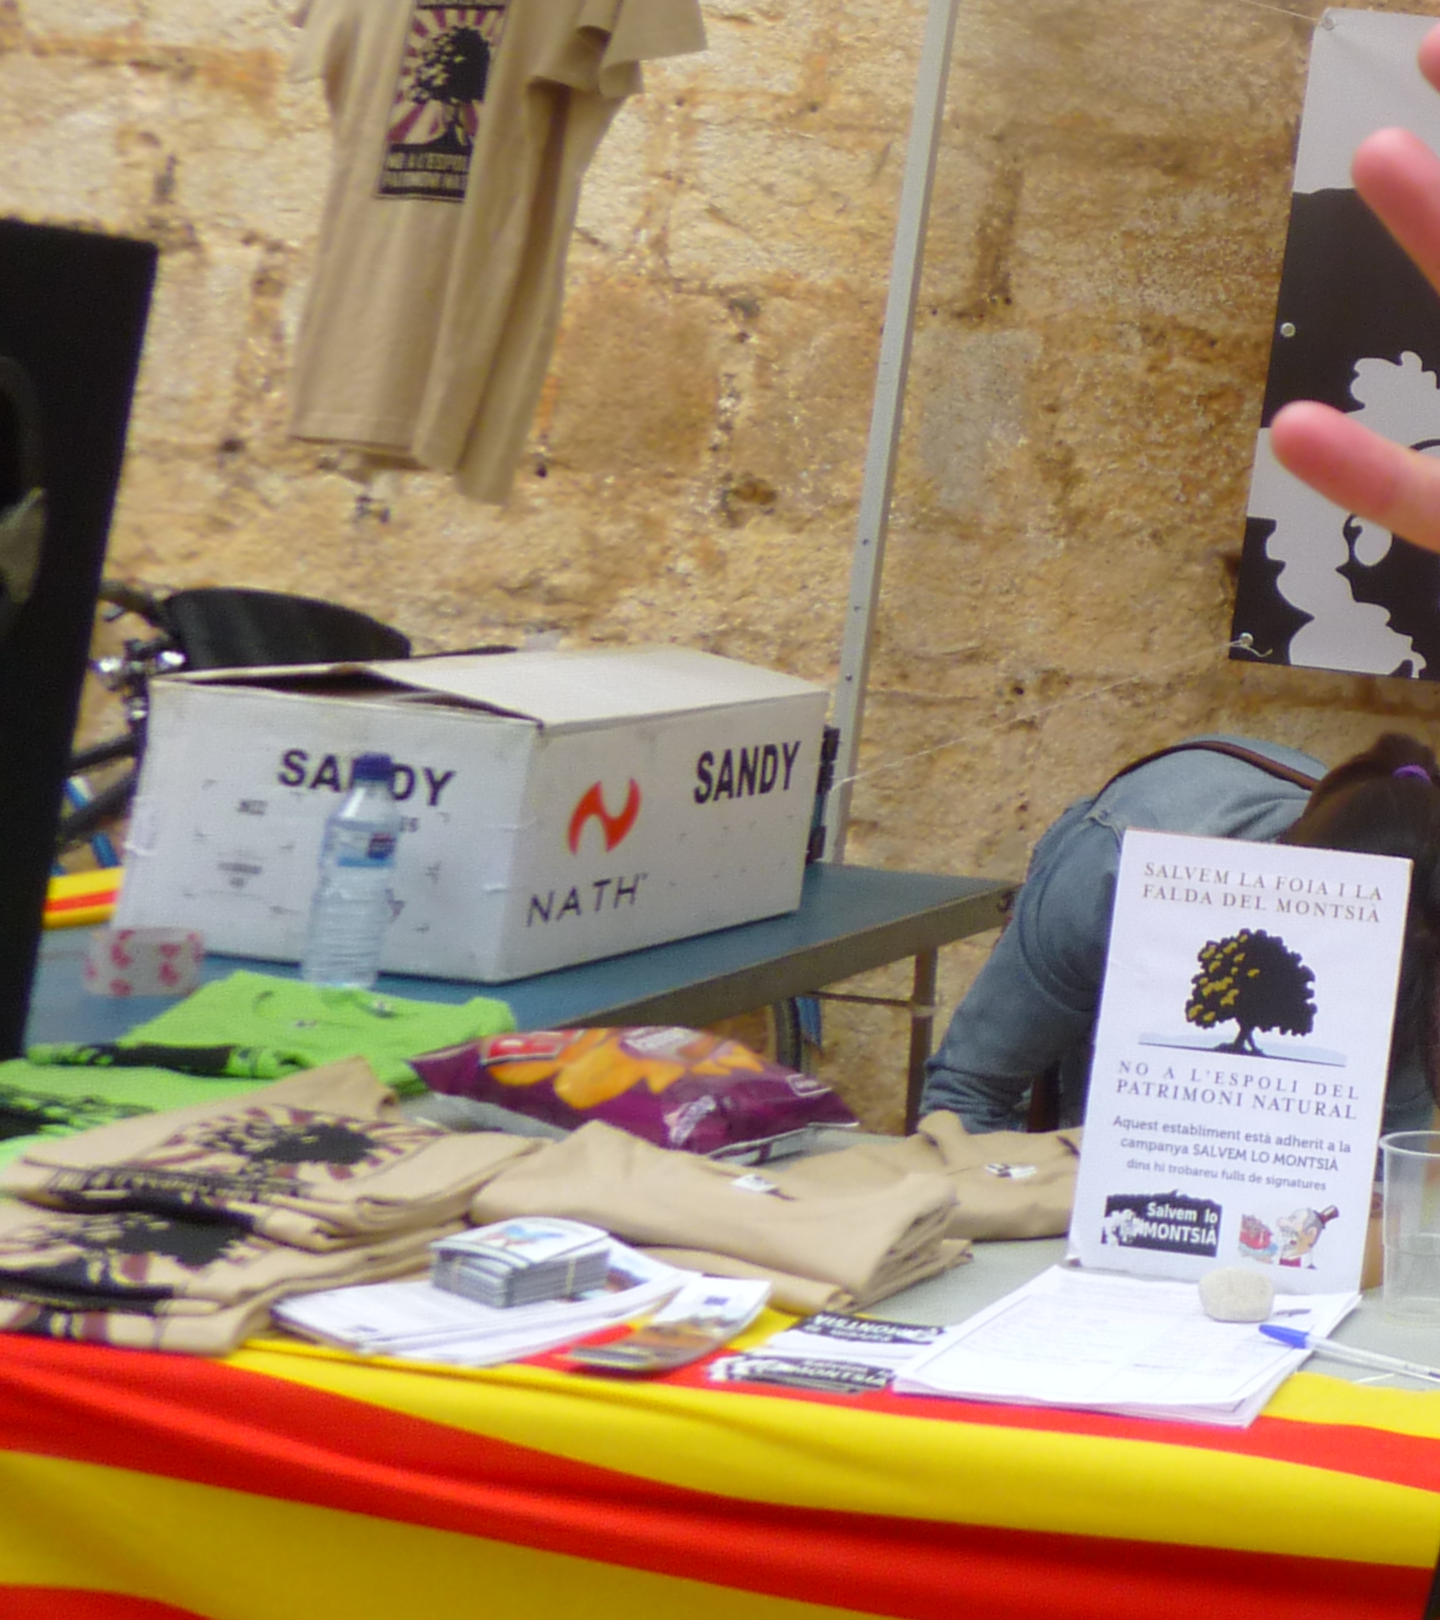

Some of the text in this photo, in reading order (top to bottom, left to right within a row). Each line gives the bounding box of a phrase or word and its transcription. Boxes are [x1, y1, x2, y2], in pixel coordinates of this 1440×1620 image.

[277, 748, 457, 807] SADY
[694, 740, 800, 805] SANDY
[1144, 862, 1383, 901] SALVEM LA FOIA I LA
[526, 875, 641, 928] NATH
[1142, 883, 1380, 923] FALDA DEL MONTSIÀ
[1116, 1078, 1357, 1120] PATRIMONI NATURAL
[1118, 1060, 1359, 1100] NO A L'ESPOLI DEL
[1112, 1115, 1159, 1132] Aquest
[1162, 1123, 1241, 1141] establiment
[1275, 1134, 1324, 1151] adherit
[1327, 1142, 1336, 1152] a
[1339, 1140, 1351, 1153] la
[1120, 1137, 1189, 1156] campanya
[1192, 1143, 1248, 1161] SALVEM
[1251, 1150, 1270, 1163] LO
[1126, 1158, 1151, 1171] dins
[1153, 1161, 1166, 1173] hi
[1168, 1163, 1219, 1179] trobareu
[1248, 1172, 1263, 1185] de
[1265, 1174, 1327, 1192] signatures
[1146, 1201, 1218, 1224] Salvem lo
[1142, 1221, 1218, 1246] MONTSIÀ
